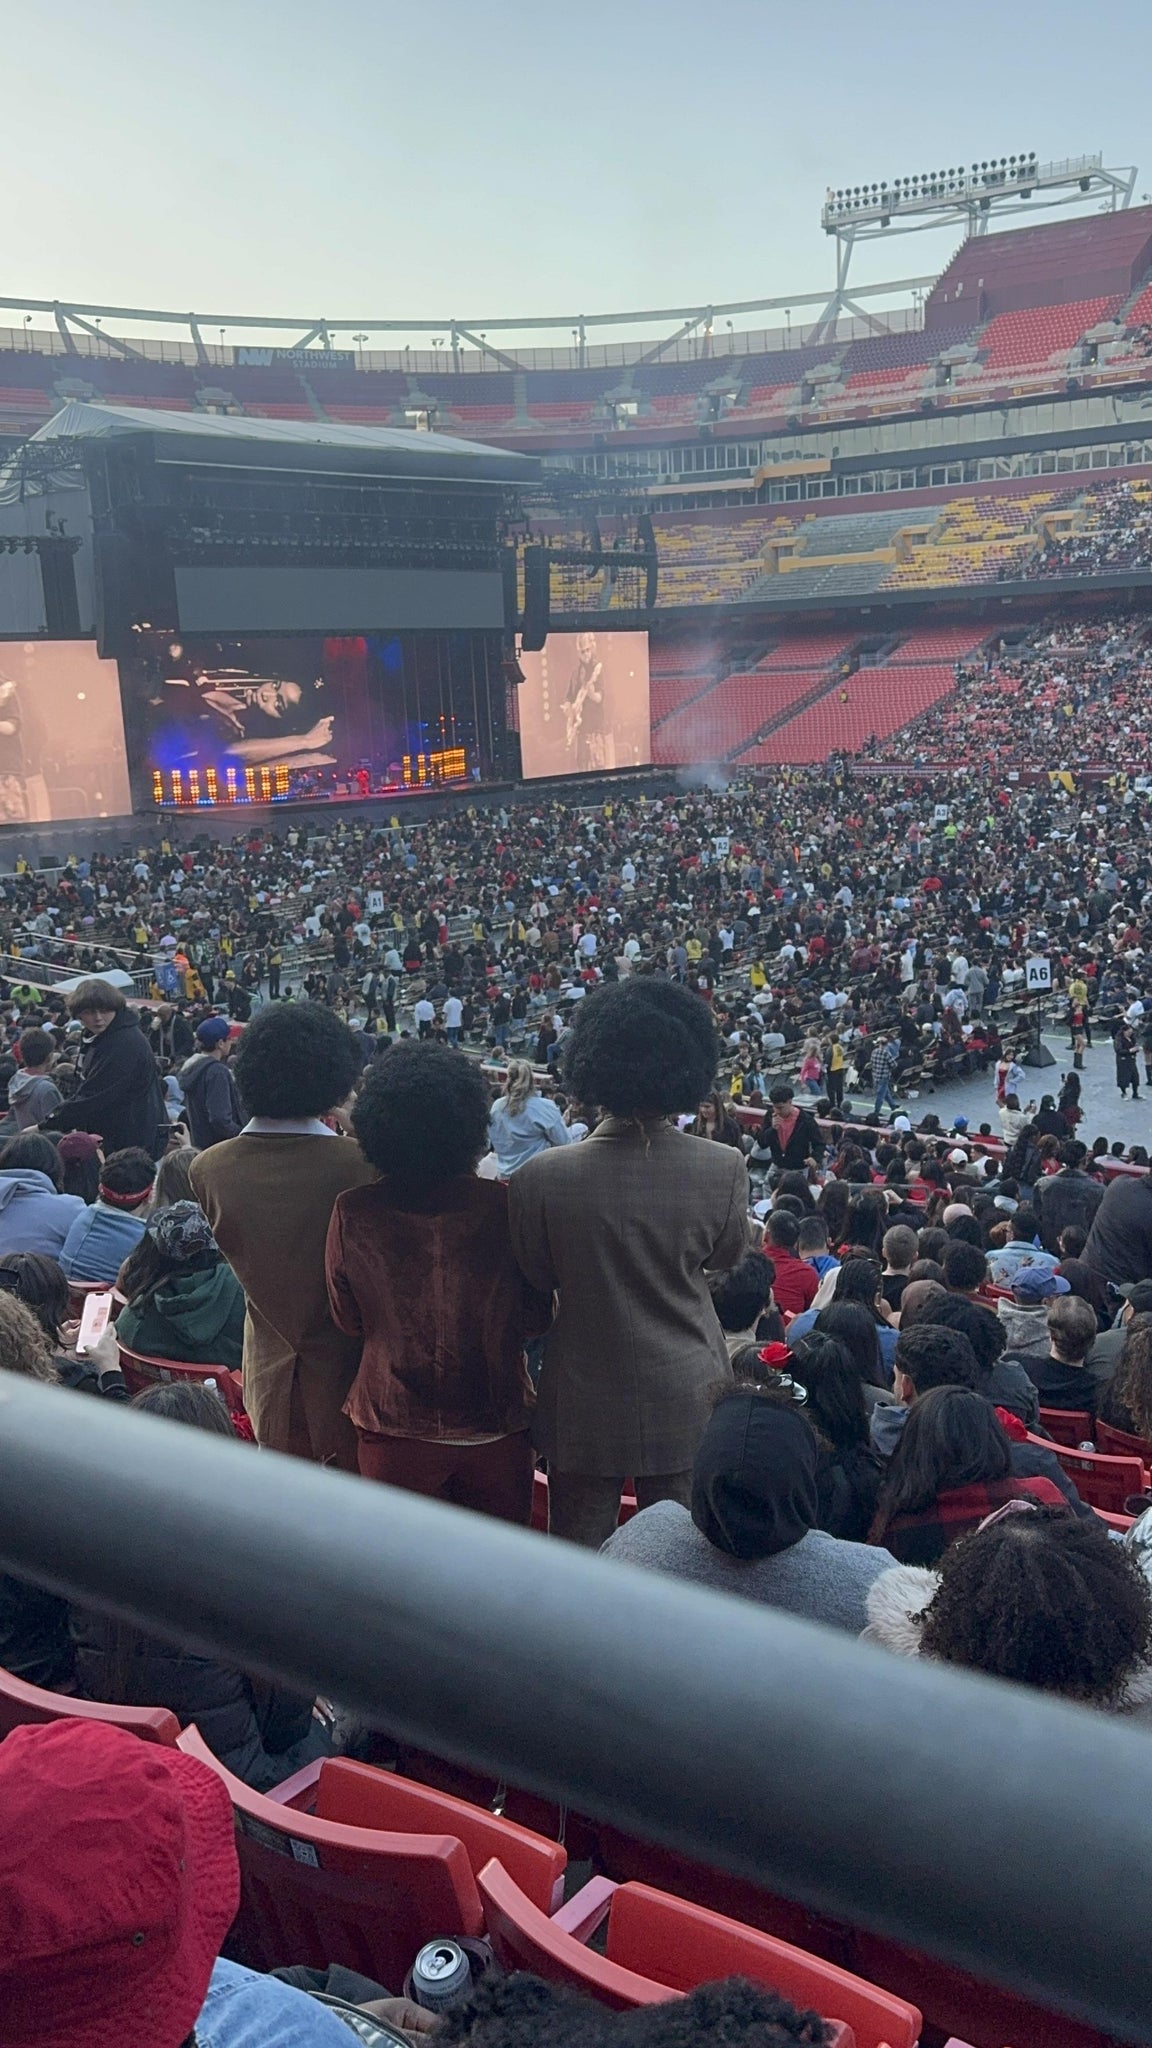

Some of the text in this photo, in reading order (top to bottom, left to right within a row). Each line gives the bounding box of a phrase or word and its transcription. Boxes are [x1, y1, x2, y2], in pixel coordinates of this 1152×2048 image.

[238, 348, 350, 367] NW NORTHWEST
[292, 360, 338, 369] STADIUM
[718, 842, 728, 850] A2
[372, 897, 382, 907] A1
[1030, 967, 1048, 981] A6
